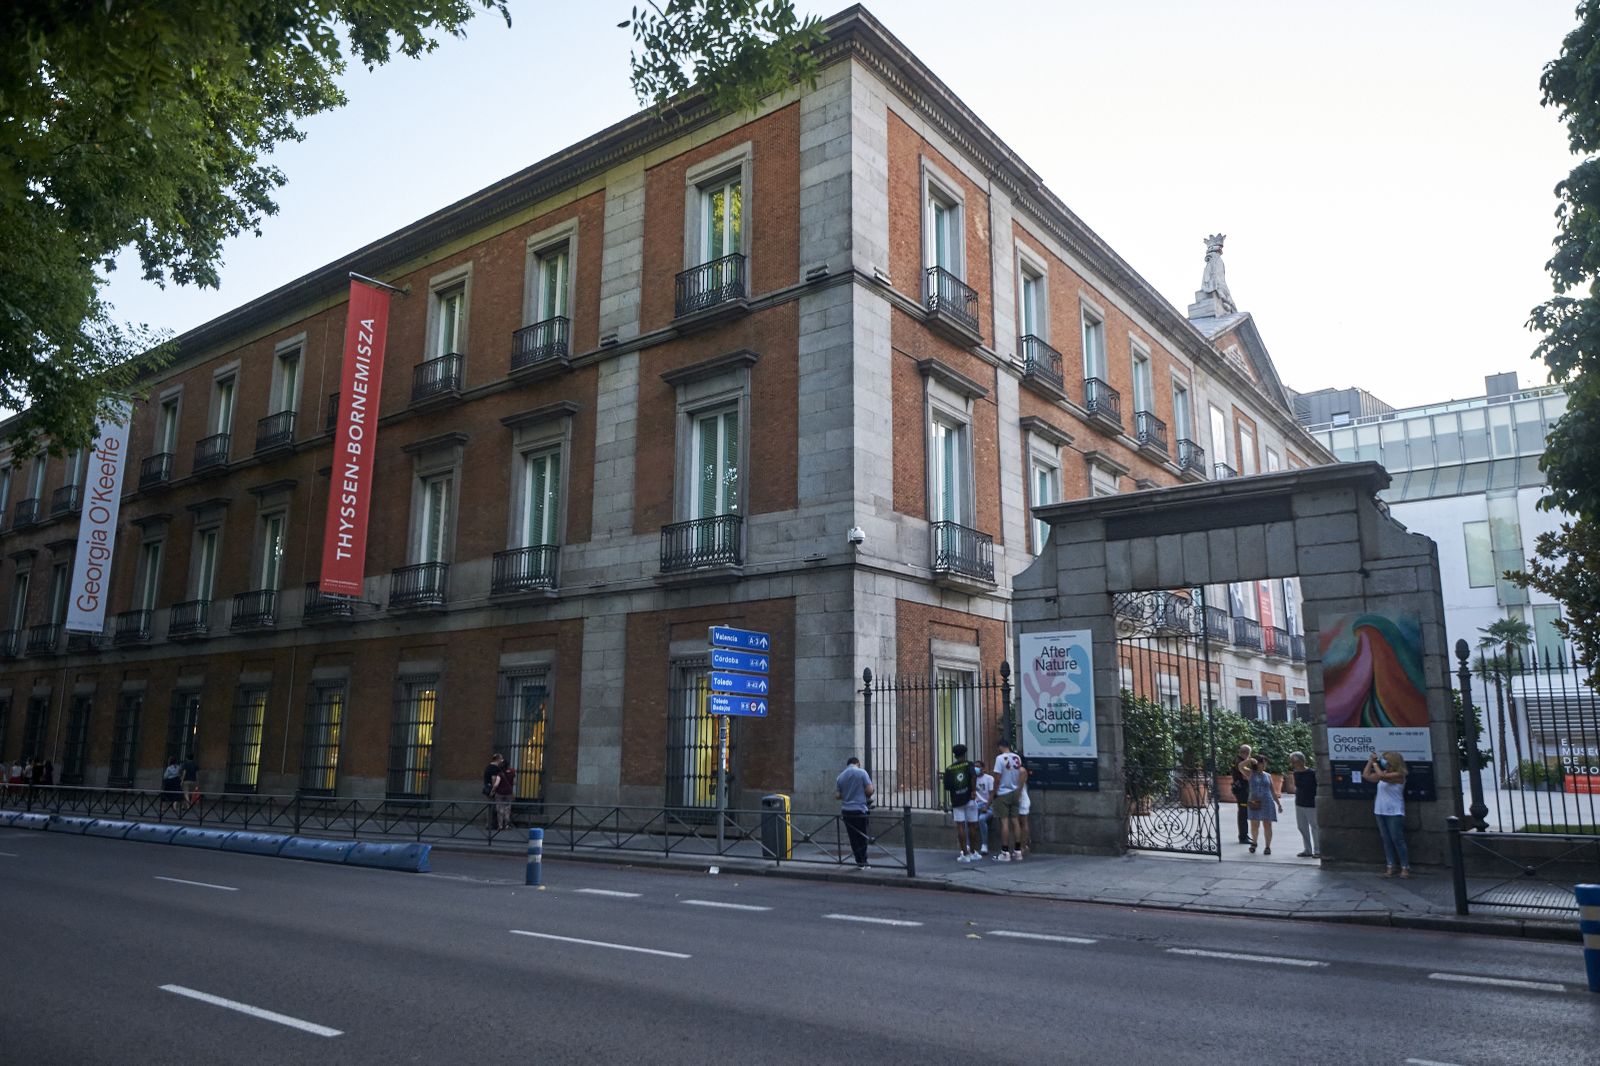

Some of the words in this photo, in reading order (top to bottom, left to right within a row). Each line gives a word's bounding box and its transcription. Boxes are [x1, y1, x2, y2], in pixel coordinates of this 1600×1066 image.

[336, 318, 375, 561] THYSSEN-BORNEMISZA
[88, 437, 120, 525] O'Keeffe
[77, 529, 111, 613] Georgia
[715, 632, 738, 642] Valencia
[1040, 645, 1071, 658] After
[1035, 658, 1078, 671] Nature
[714, 677, 733, 686] Toledo
[713, 697, 729, 705] Toledo
[712, 704, 731, 712] Badajoz
[1034, 707, 1083, 721] Claudia
[1037, 720, 1081, 734] Comte
[1333, 734, 1373, 746] Georgia
[1333, 743, 1376, 753] O'Keeffe
[1563, 756, 1579, 765] DE
